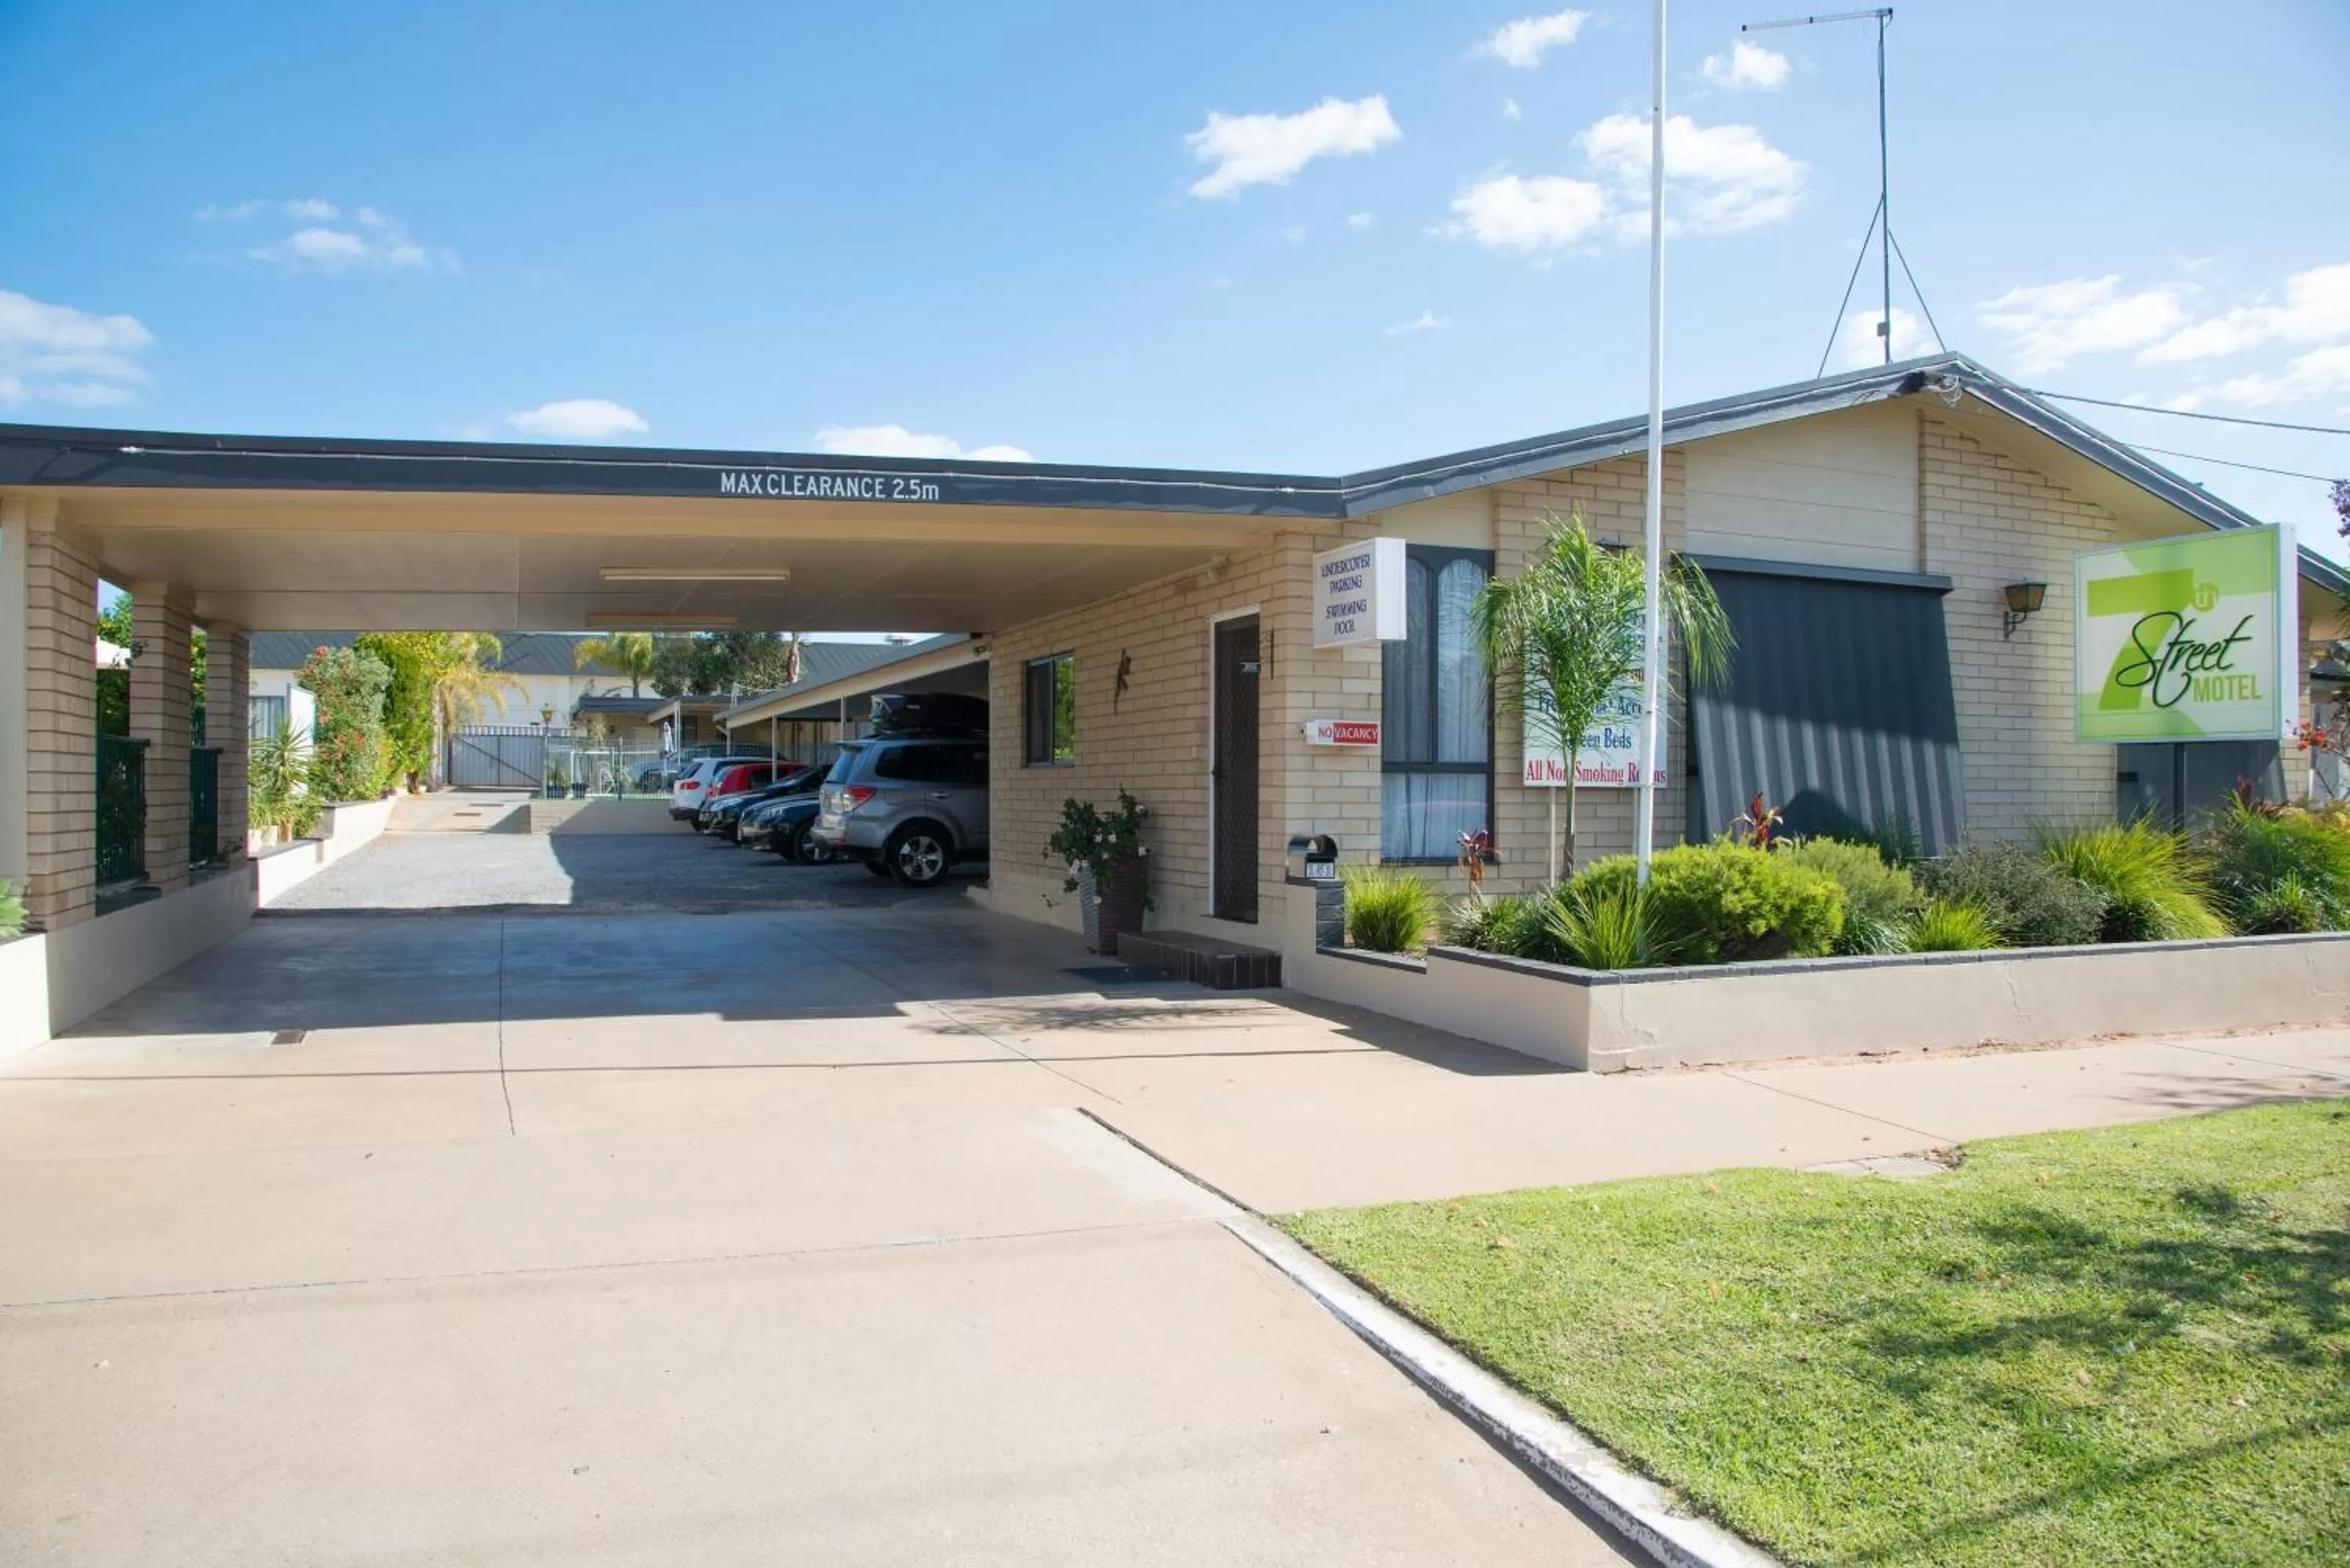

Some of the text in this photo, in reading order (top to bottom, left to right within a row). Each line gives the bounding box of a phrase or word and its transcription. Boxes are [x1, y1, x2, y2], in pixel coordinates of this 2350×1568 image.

[721, 472, 939, 500] MAX CLEARANCE 2.5m
[1321, 554, 1371, 577] UNDERCOVER
[1330, 575, 1362, 594] PARKING
[1325, 598, 1367, 620] SWIMMING
[1334, 619, 1355, 635] POOL
[2116, 611, 2254, 708] Street
[2193, 674, 2262, 703] MOTEL
[1318, 726, 1378, 740] NO VACANCY
[1604, 728, 1632, 750] Beds
[1526, 759, 1542, 781] All
[1575, 760, 1624, 786] Smoking
